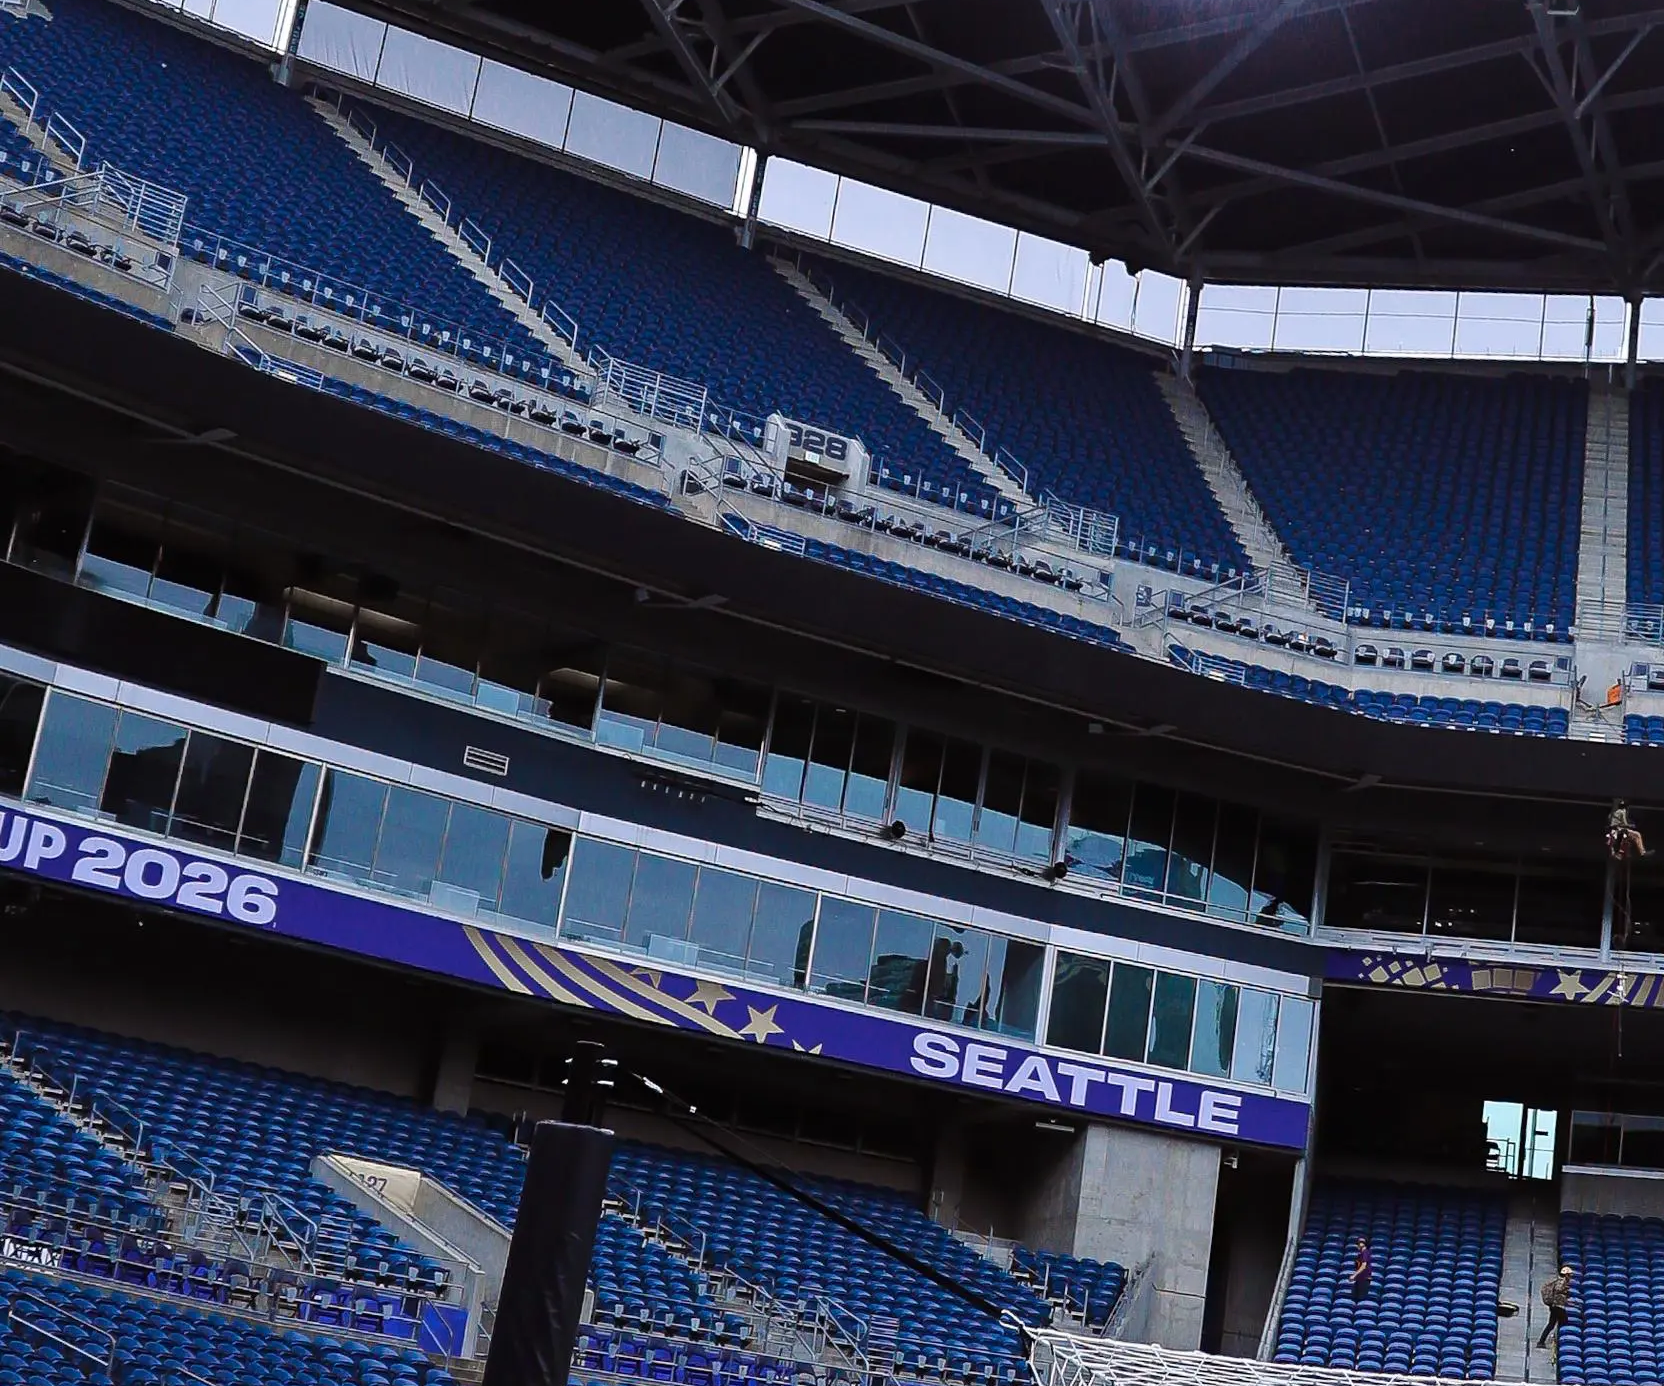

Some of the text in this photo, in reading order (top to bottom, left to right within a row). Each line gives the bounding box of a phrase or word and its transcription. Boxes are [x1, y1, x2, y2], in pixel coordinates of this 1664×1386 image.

[786, 422, 848, 461] 328
[71, 836, 279, 925] 2026
[910, 1032, 1242, 1134] SEATTLE
